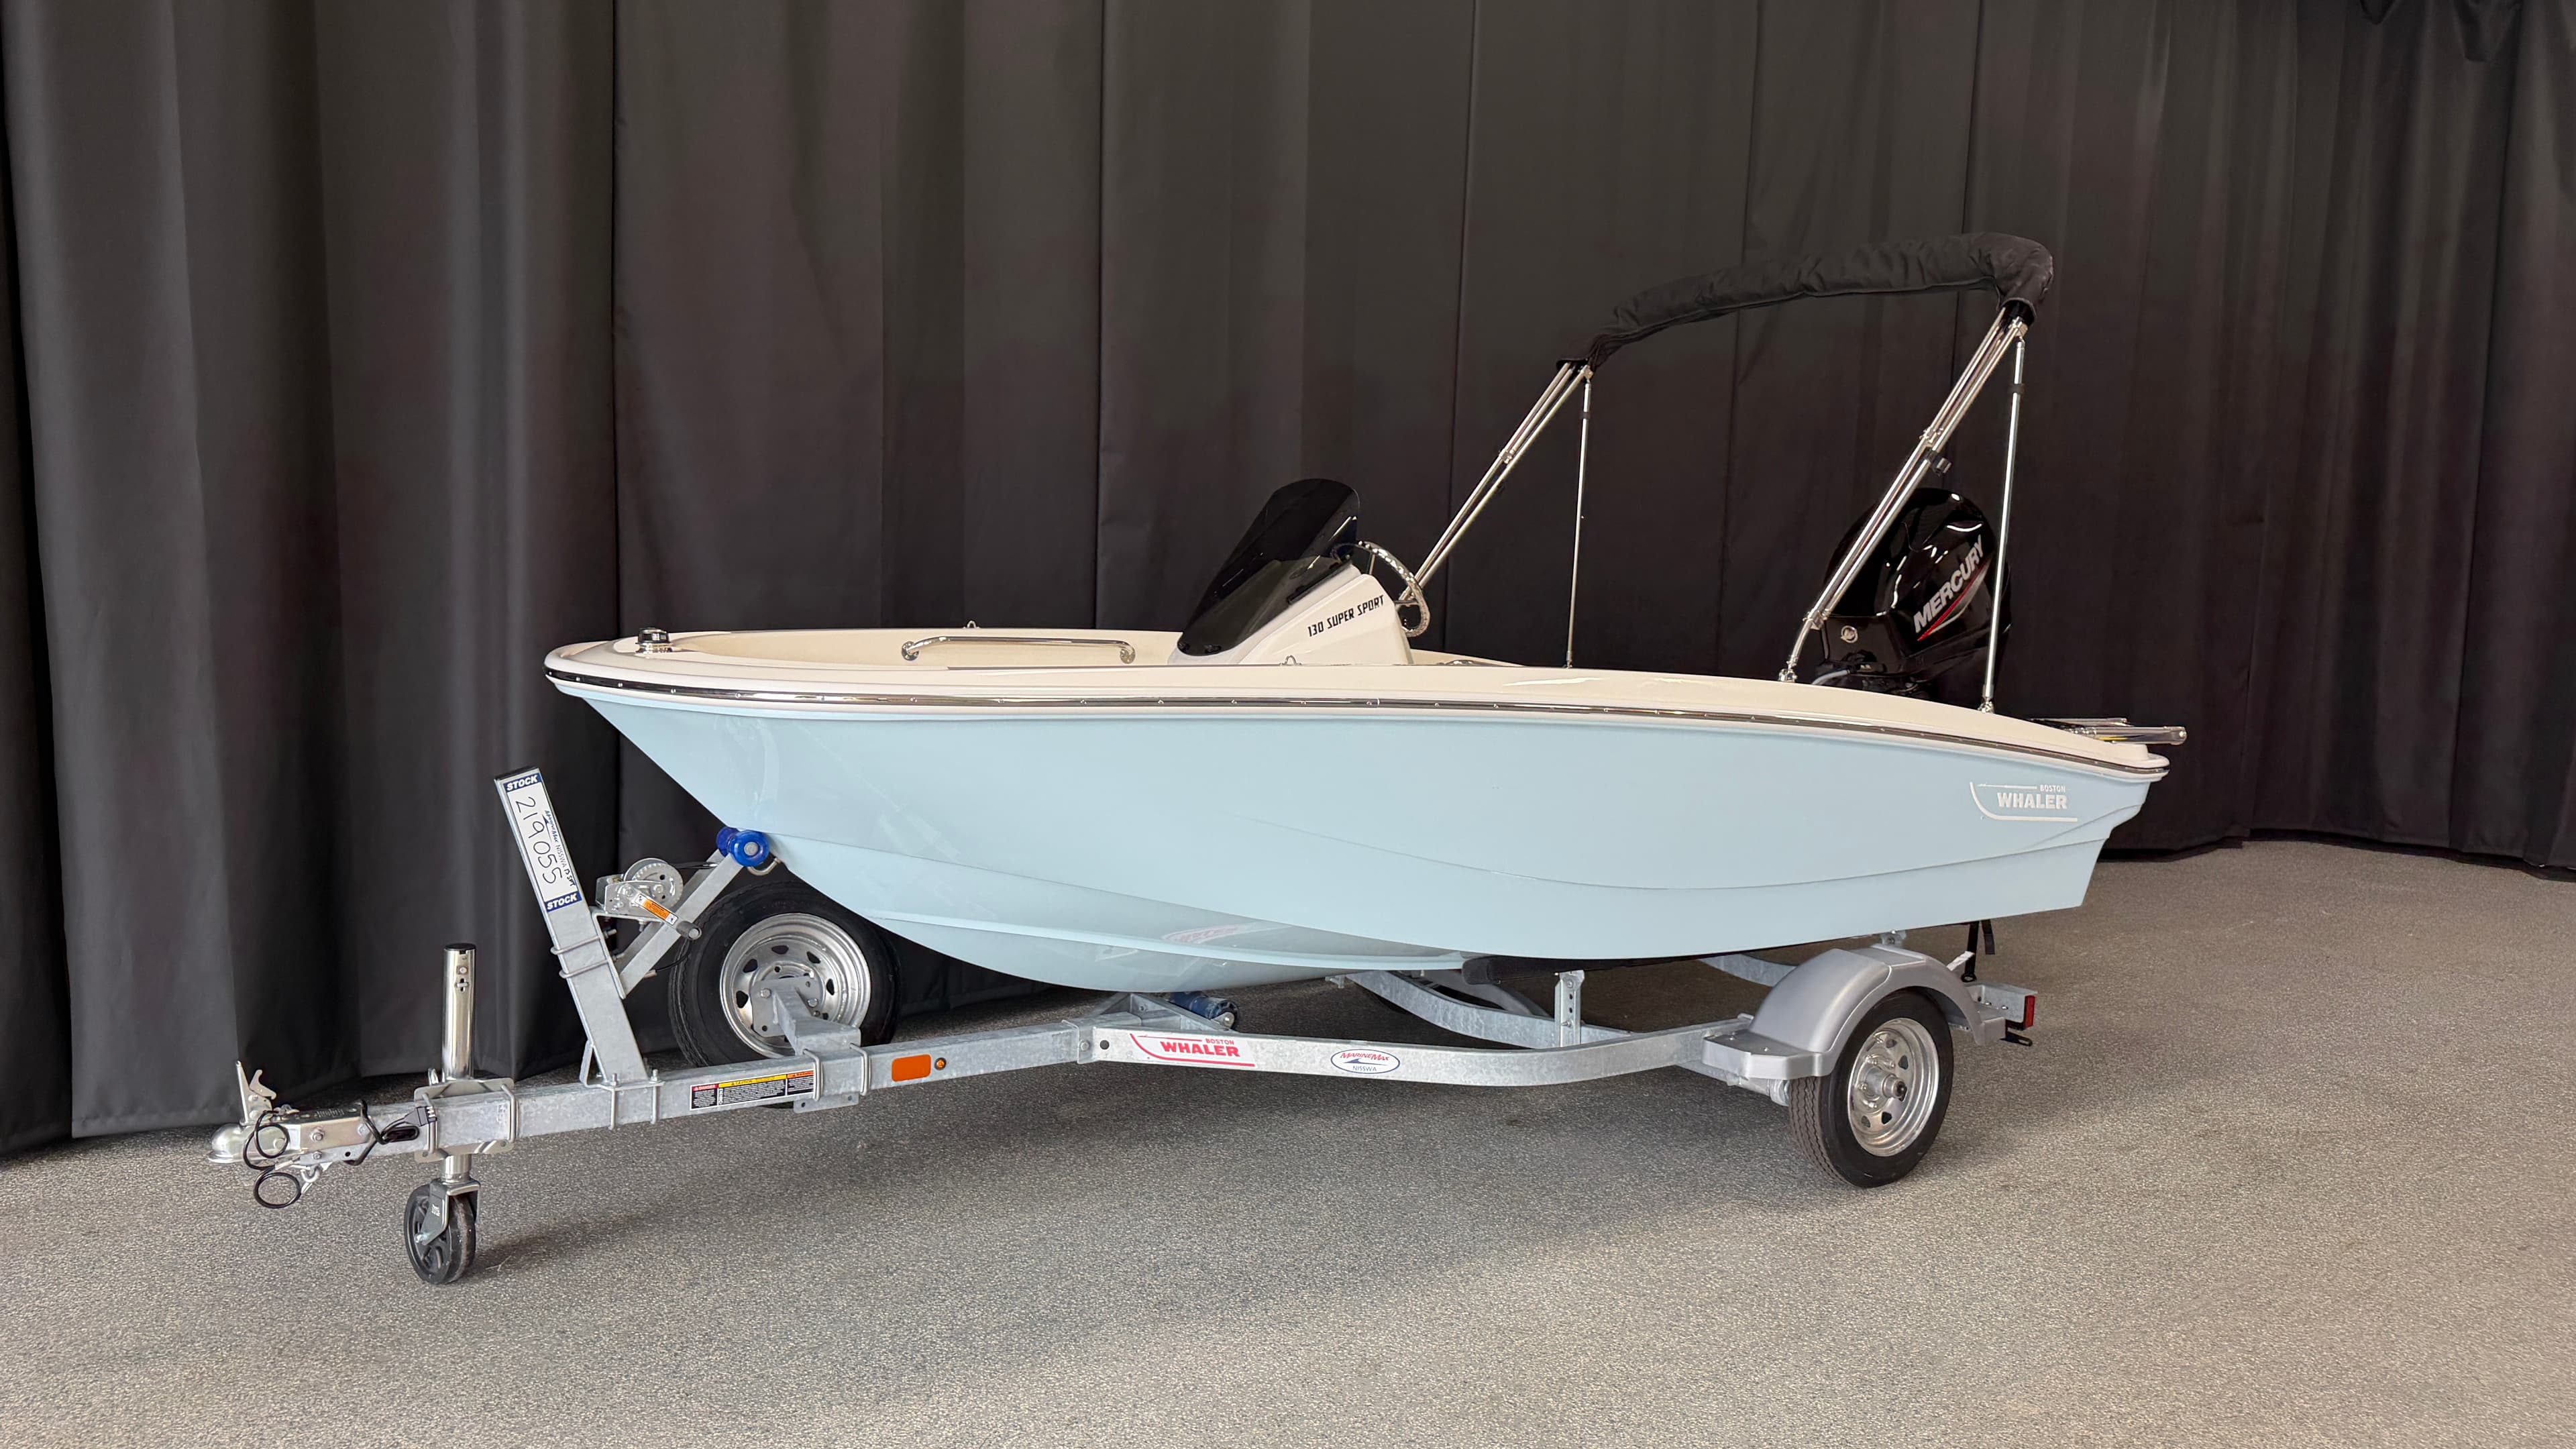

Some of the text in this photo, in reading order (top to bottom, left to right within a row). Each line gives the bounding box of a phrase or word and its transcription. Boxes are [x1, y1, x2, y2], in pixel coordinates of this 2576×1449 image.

[1913, 534, 1984, 633] MERCURY
[1307, 594, 1383, 637] 130 SUPER SPORT
[506, 774, 539, 792] STOCK
[2039, 784, 2066, 793] BOSTON
[1996, 792, 2068, 810] WHALER
[555, 845, 568, 867] NISSWA
[547, 893, 578, 910] STOCK
[1159, 1040, 1240, 1057] WHALER
